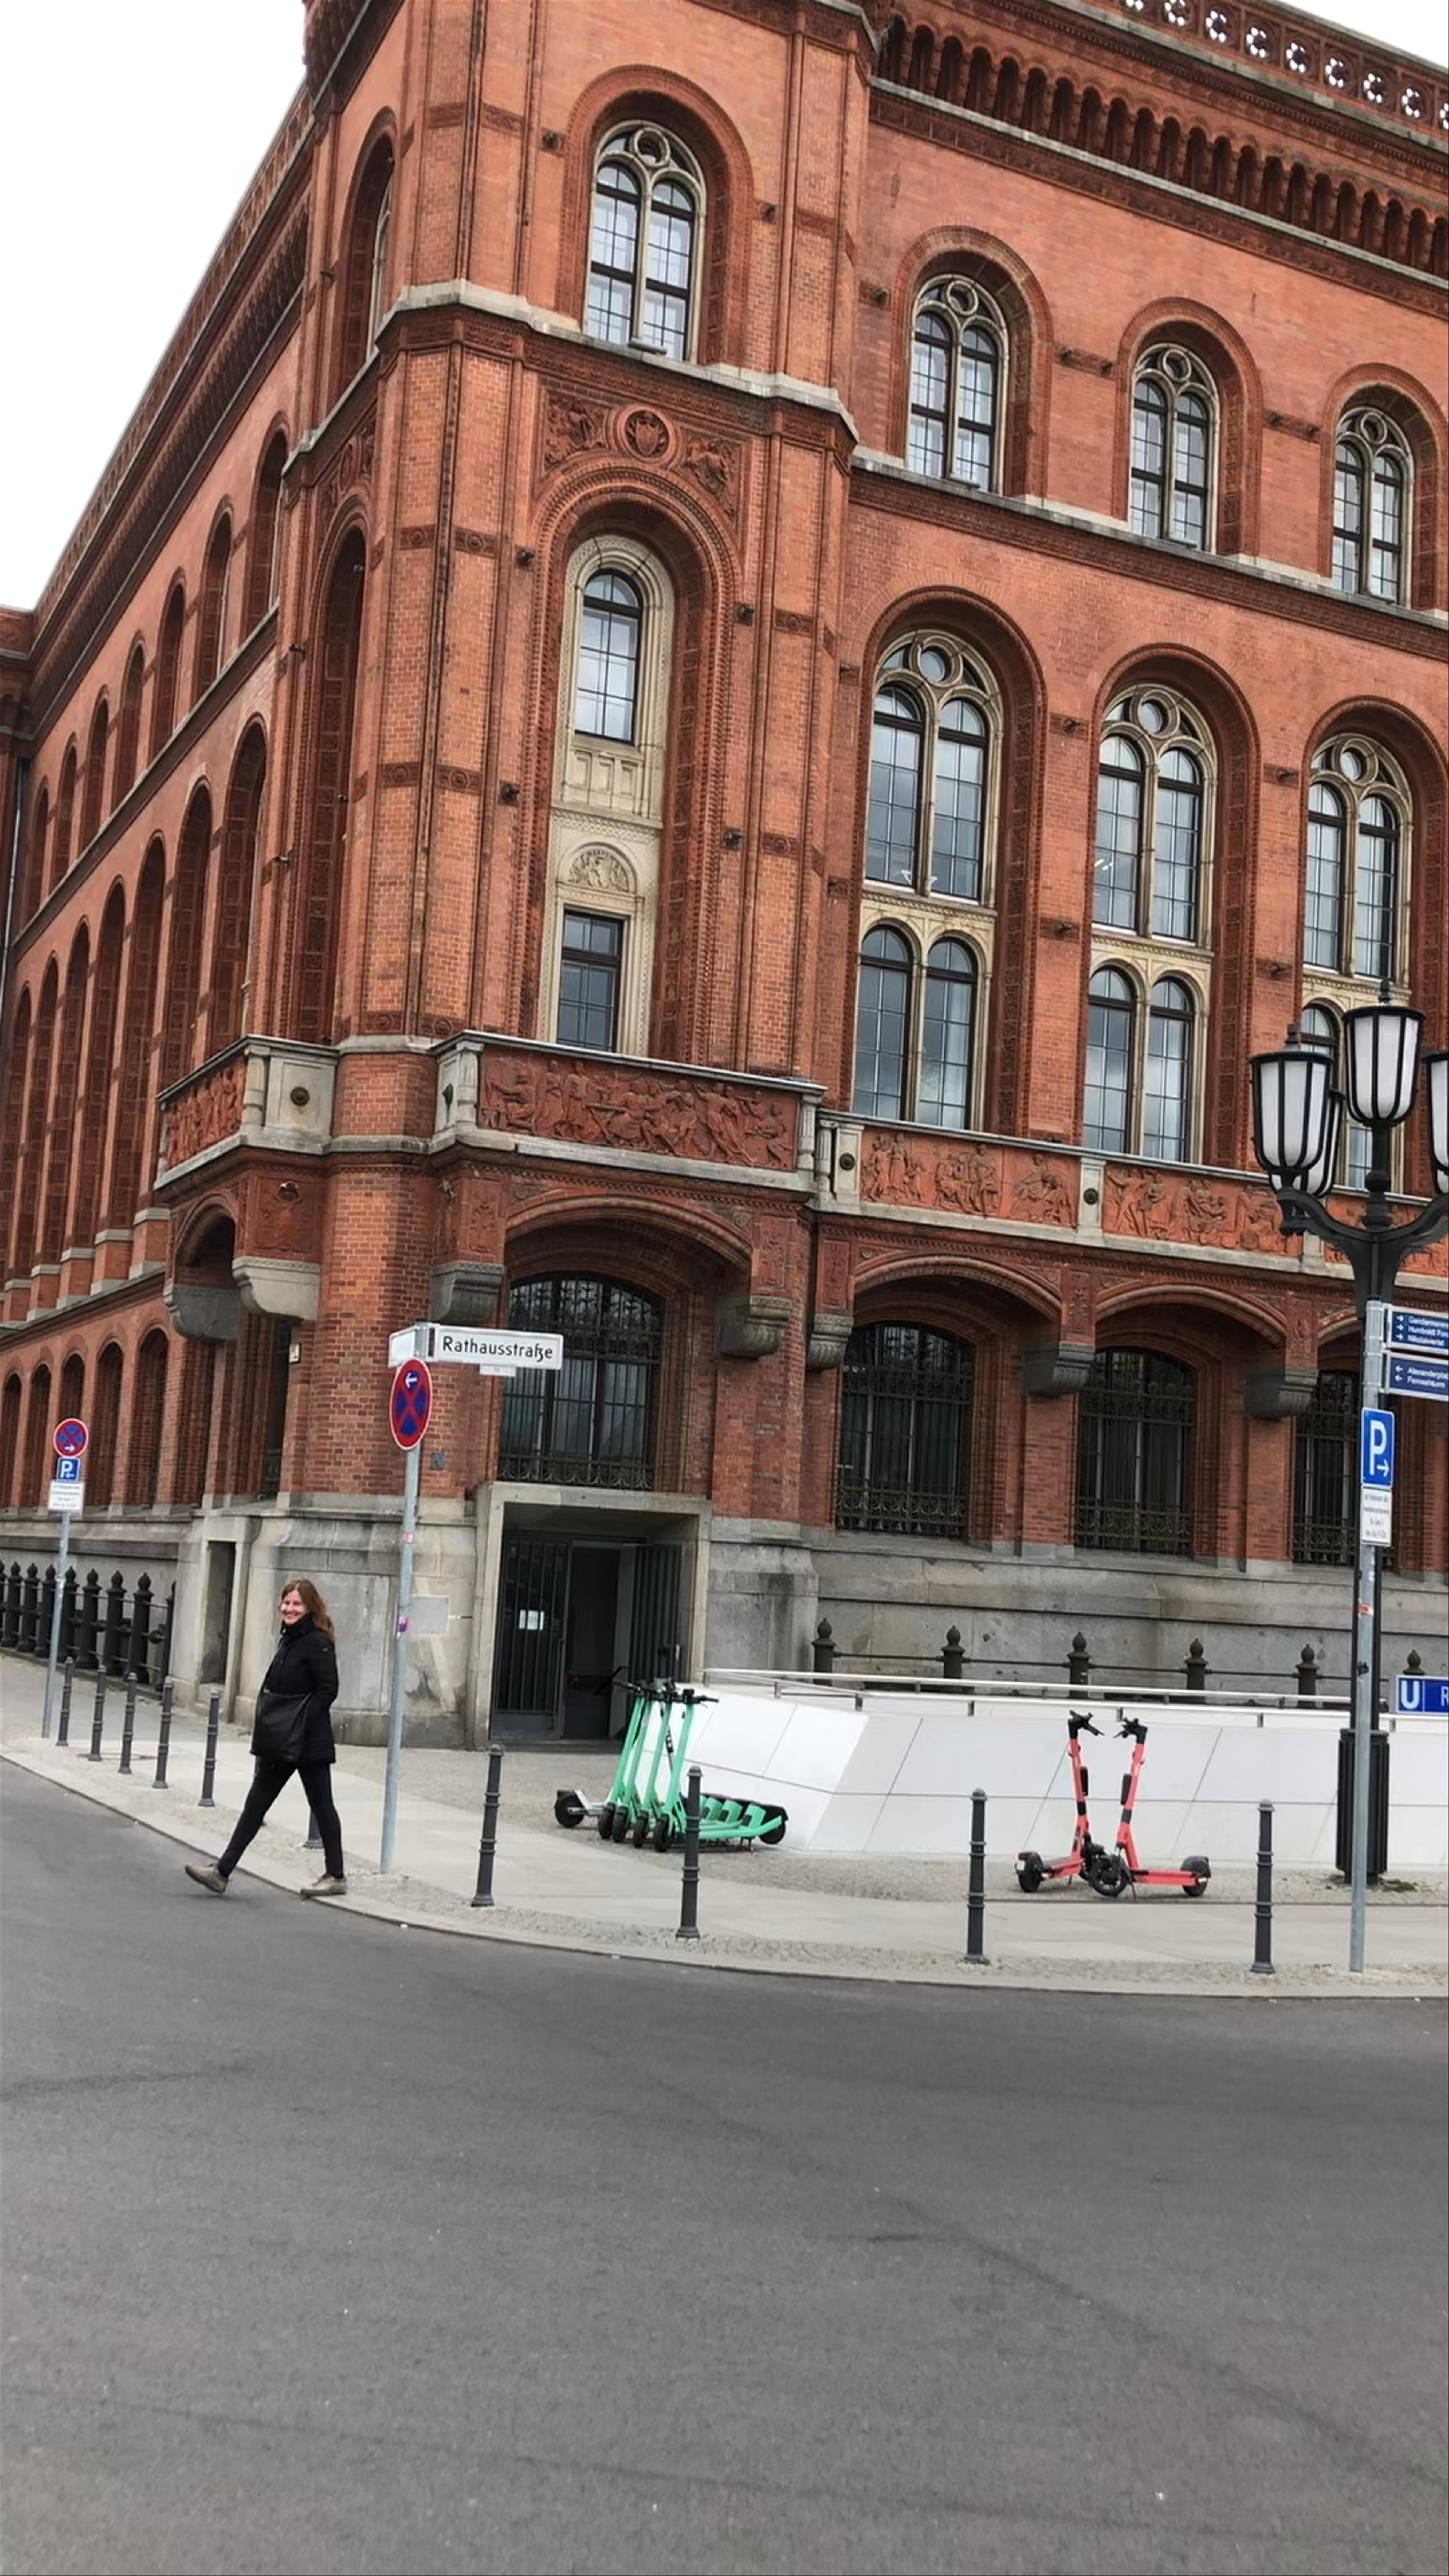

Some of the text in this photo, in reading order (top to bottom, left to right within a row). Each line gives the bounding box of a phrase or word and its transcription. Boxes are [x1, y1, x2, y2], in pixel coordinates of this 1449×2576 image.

[1408, 1325, 1435, 1336] Humboldt
[443, 1336, 553, 1363] Rathausstraße
[1407, 1376, 1445, 1388] Fernsehturm
[1369, 1420, 1387, 1475] P
[60, 1461, 73, 1478] P
[1401, 1680, 1420, 1709] U
